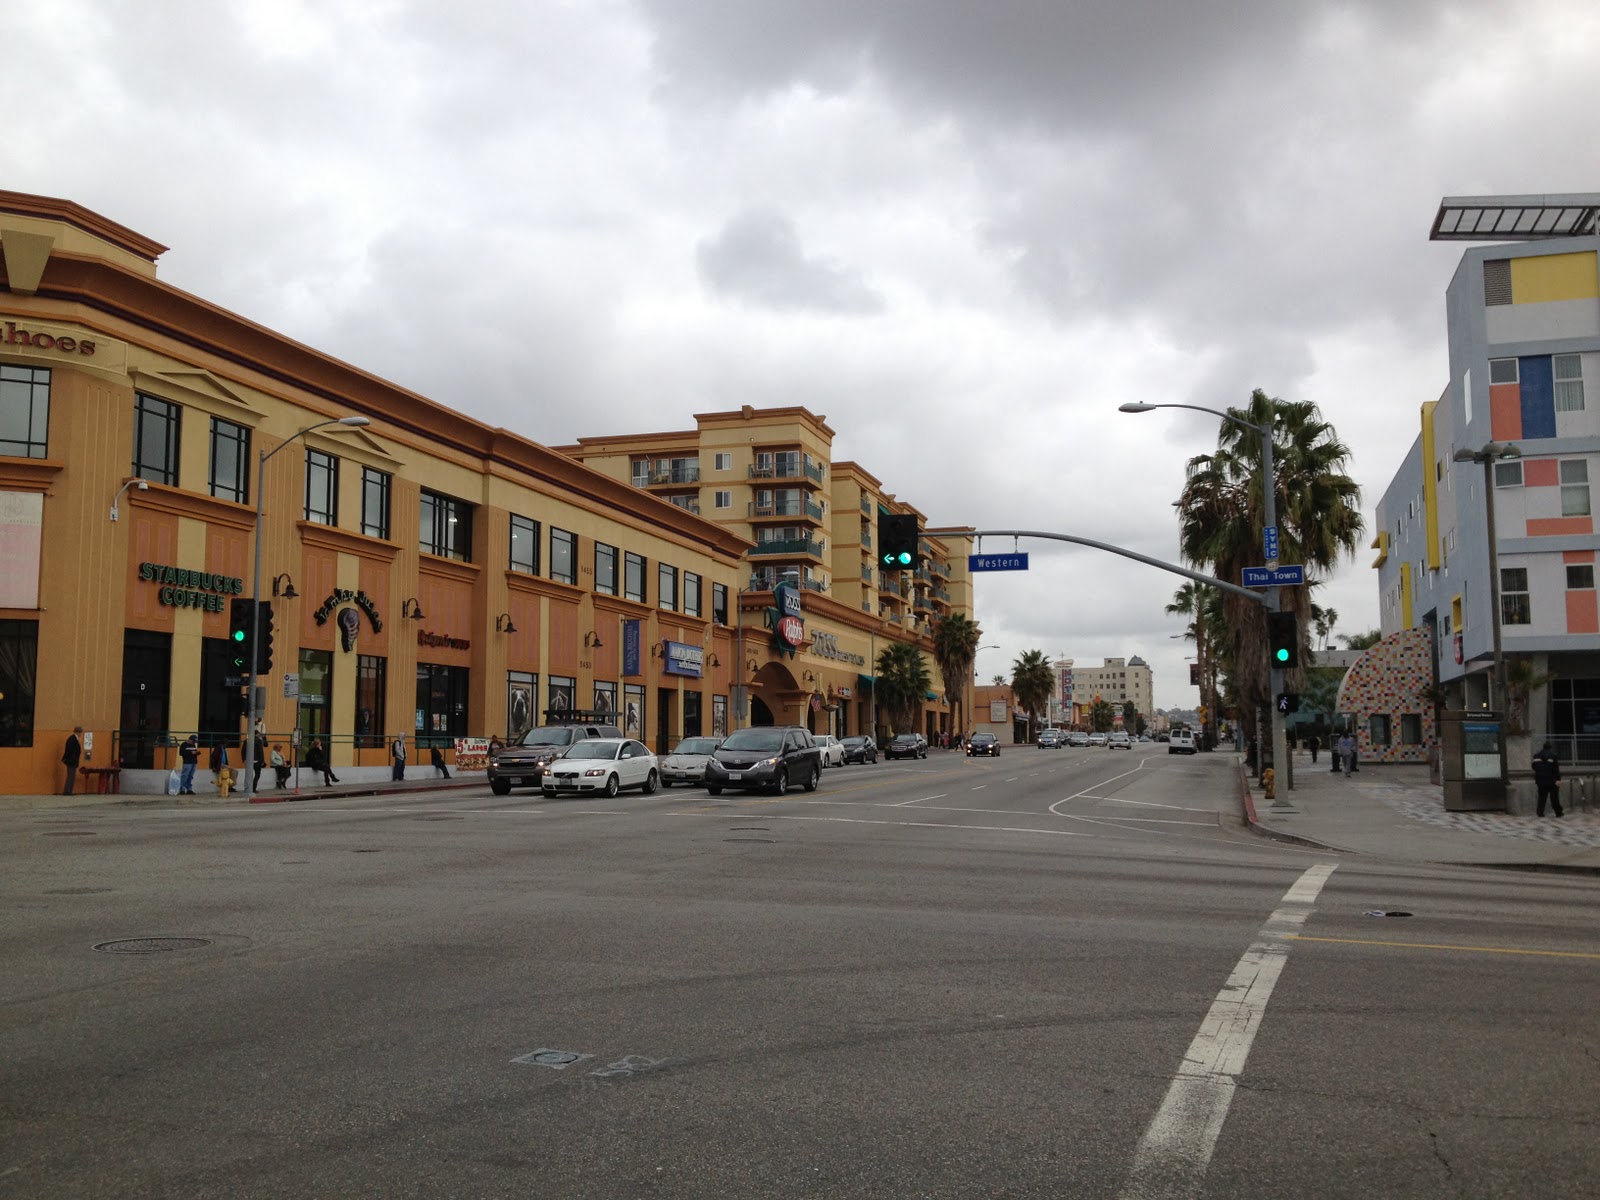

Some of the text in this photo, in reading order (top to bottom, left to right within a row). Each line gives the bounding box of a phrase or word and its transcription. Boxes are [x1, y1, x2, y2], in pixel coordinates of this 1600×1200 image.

[0, 321, 95, 356] hoes
[1269, 528, 1277, 557] SYNC
[977, 558, 1020, 568] Western
[139, 562, 243, 595] STARBUCKS
[1248, 571, 1298, 581] Thai Town
[160, 586, 226, 612] COFFEE
[785, 594, 801, 611] ROSS
[785, 619, 803, 643] Ralphs
